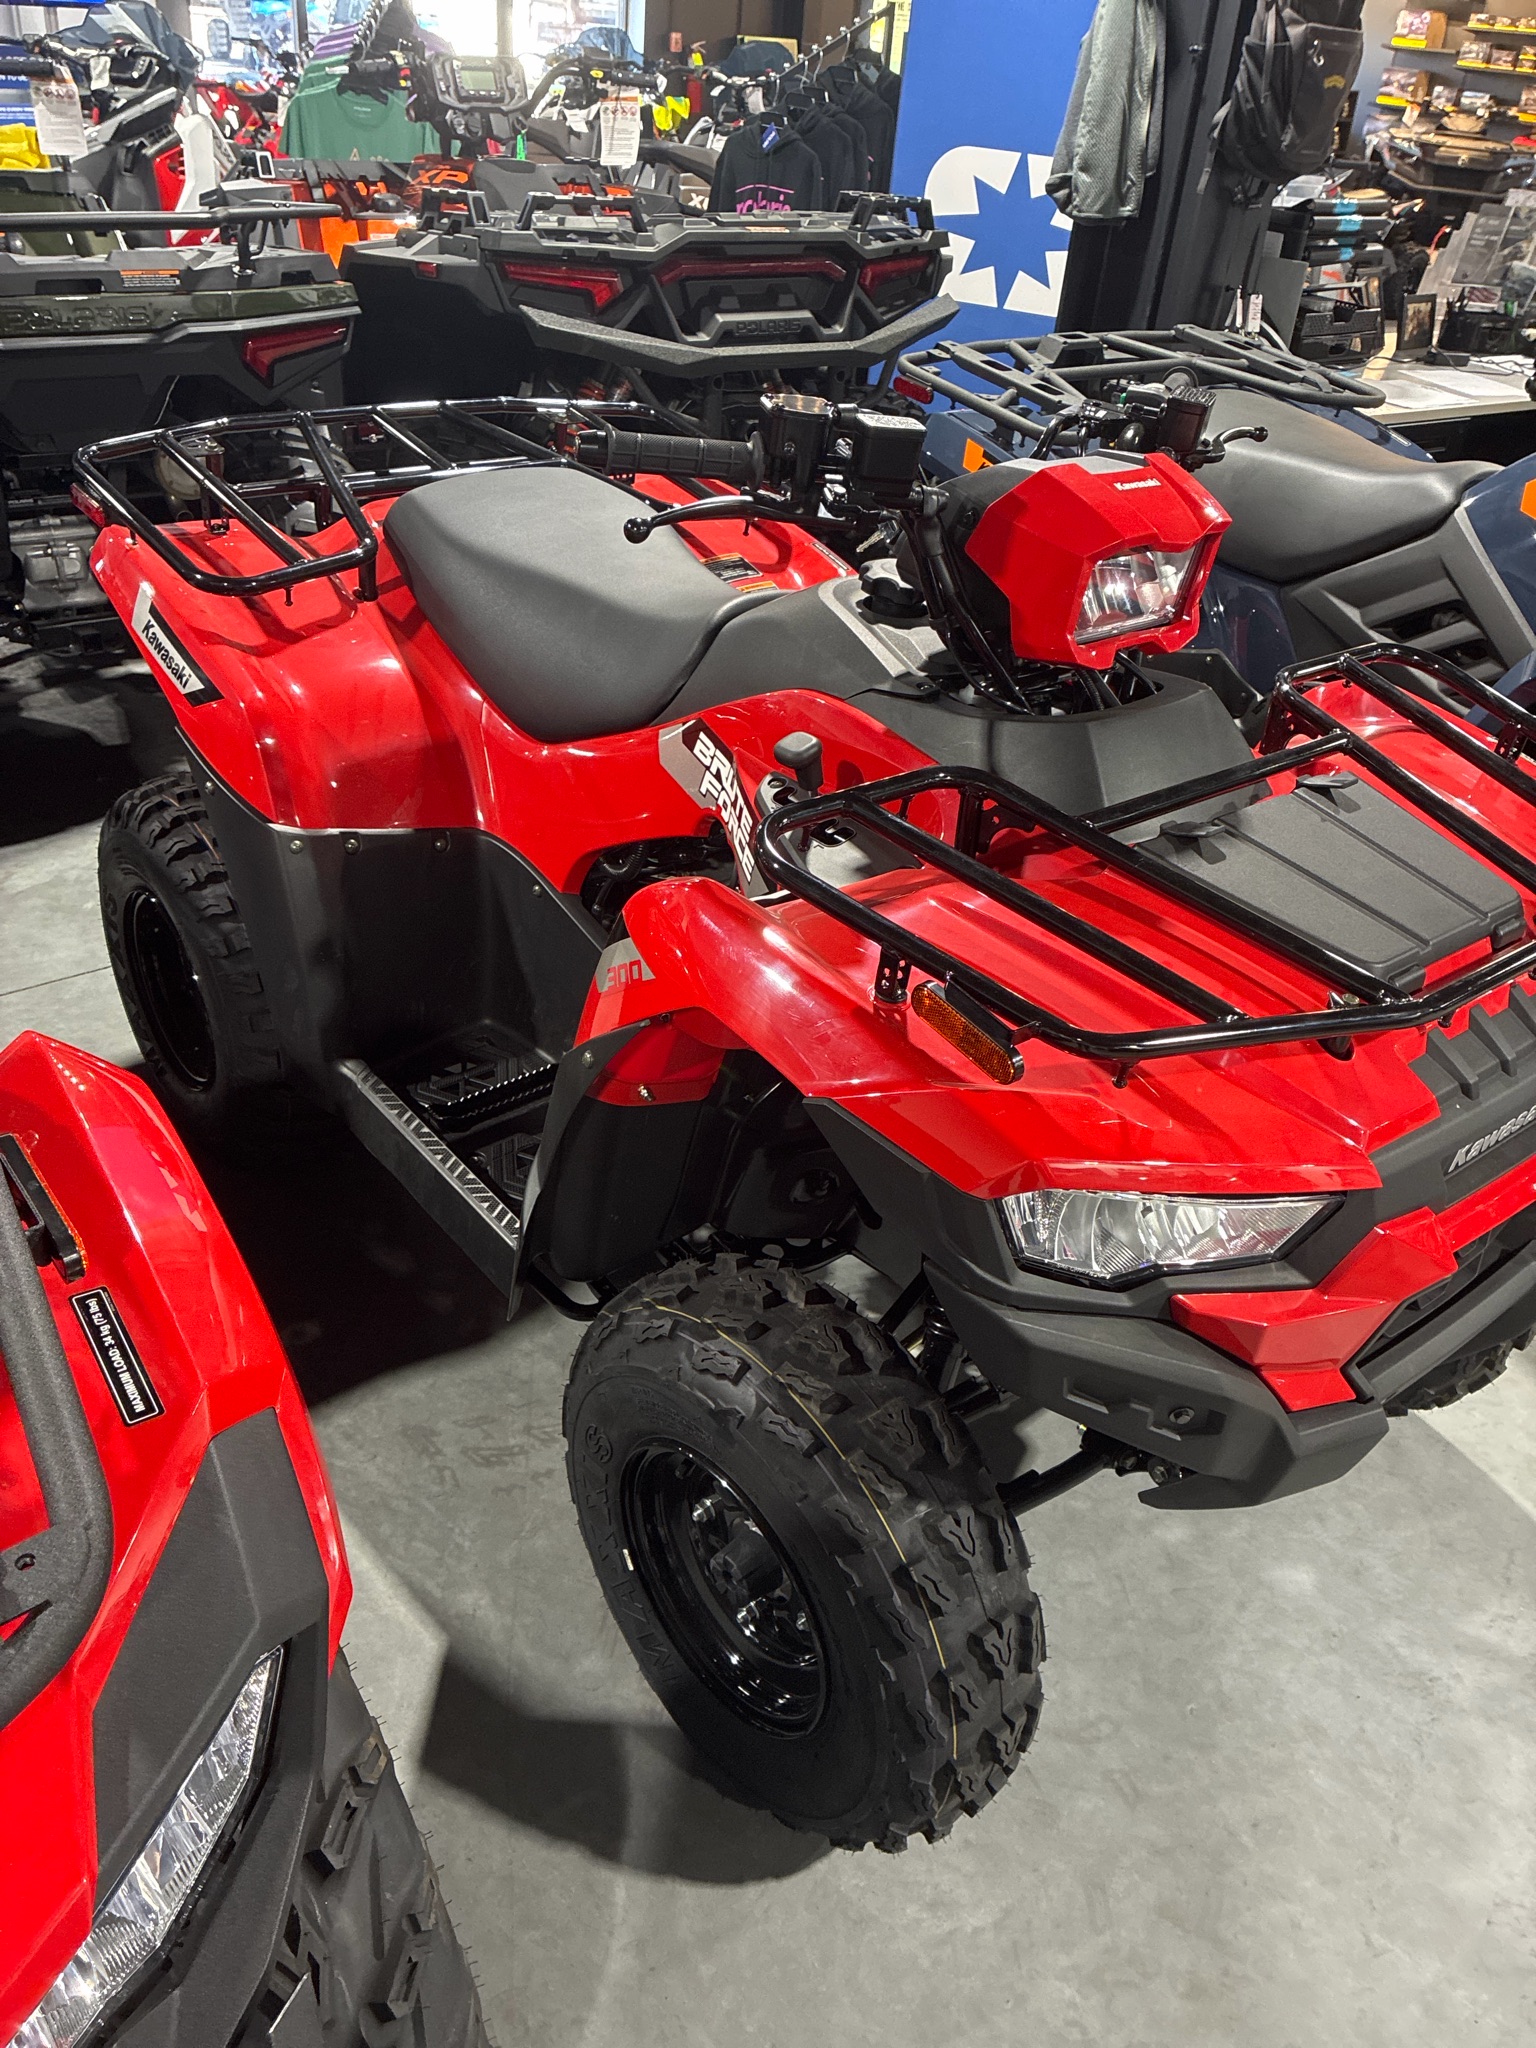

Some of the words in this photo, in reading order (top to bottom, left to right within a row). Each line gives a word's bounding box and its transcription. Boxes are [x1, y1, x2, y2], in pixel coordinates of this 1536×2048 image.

[410, 168, 469, 185] XP
[0, 304, 151, 333] POLARIS
[735, 320, 801, 336] POLARIS
[1113, 478, 1161, 491] Kawasaki
[141, 619, 192, 689] Kawasaki
[693, 731, 753, 843] BRUTE
[699, 769, 755, 883] FORCE
[607, 959, 643, 989] 300
[85, 1298, 100, 1314] lbs)
[92, 1312, 107, 1326] (75
[100, 1324, 111, 1337] kg
[102, 1335, 115, 1347] 34
[108, 1346, 128, 1373] LOAD:
[119, 1371, 146, 1413] MAXIMUM
